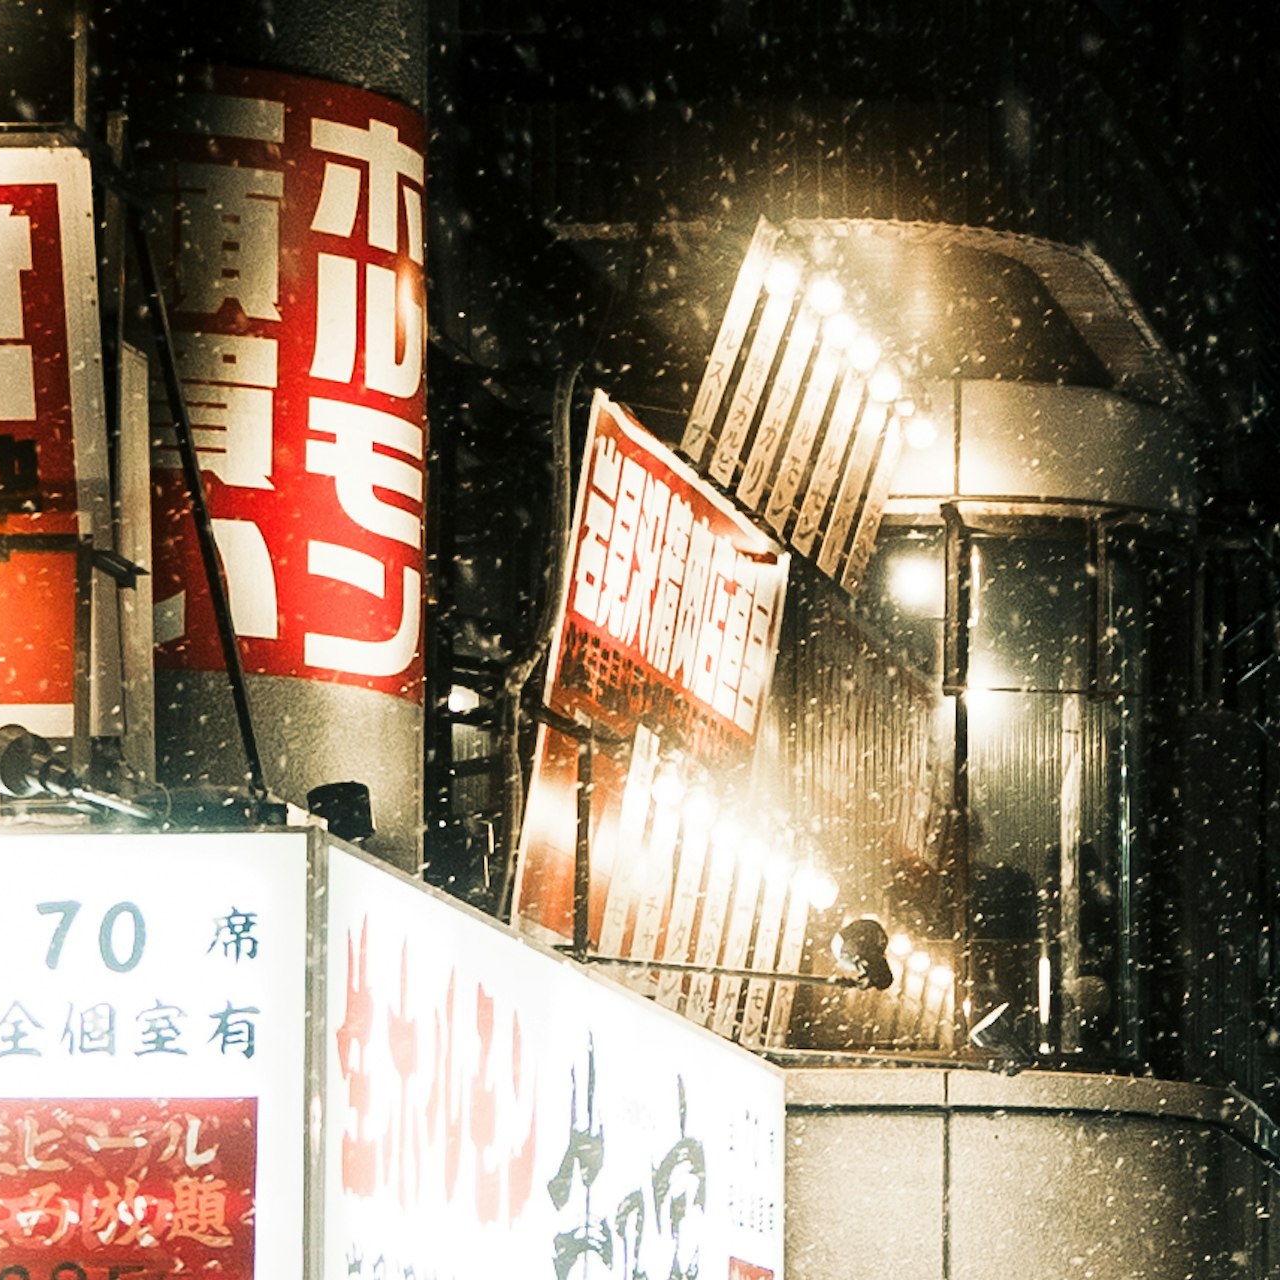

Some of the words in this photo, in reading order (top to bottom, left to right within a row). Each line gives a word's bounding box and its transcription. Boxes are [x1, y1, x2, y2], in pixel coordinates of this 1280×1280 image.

[303, 117, 426, 678] ホルモン
[36, 899, 148, 973] 70
[205, 905, 262, 964] 席
